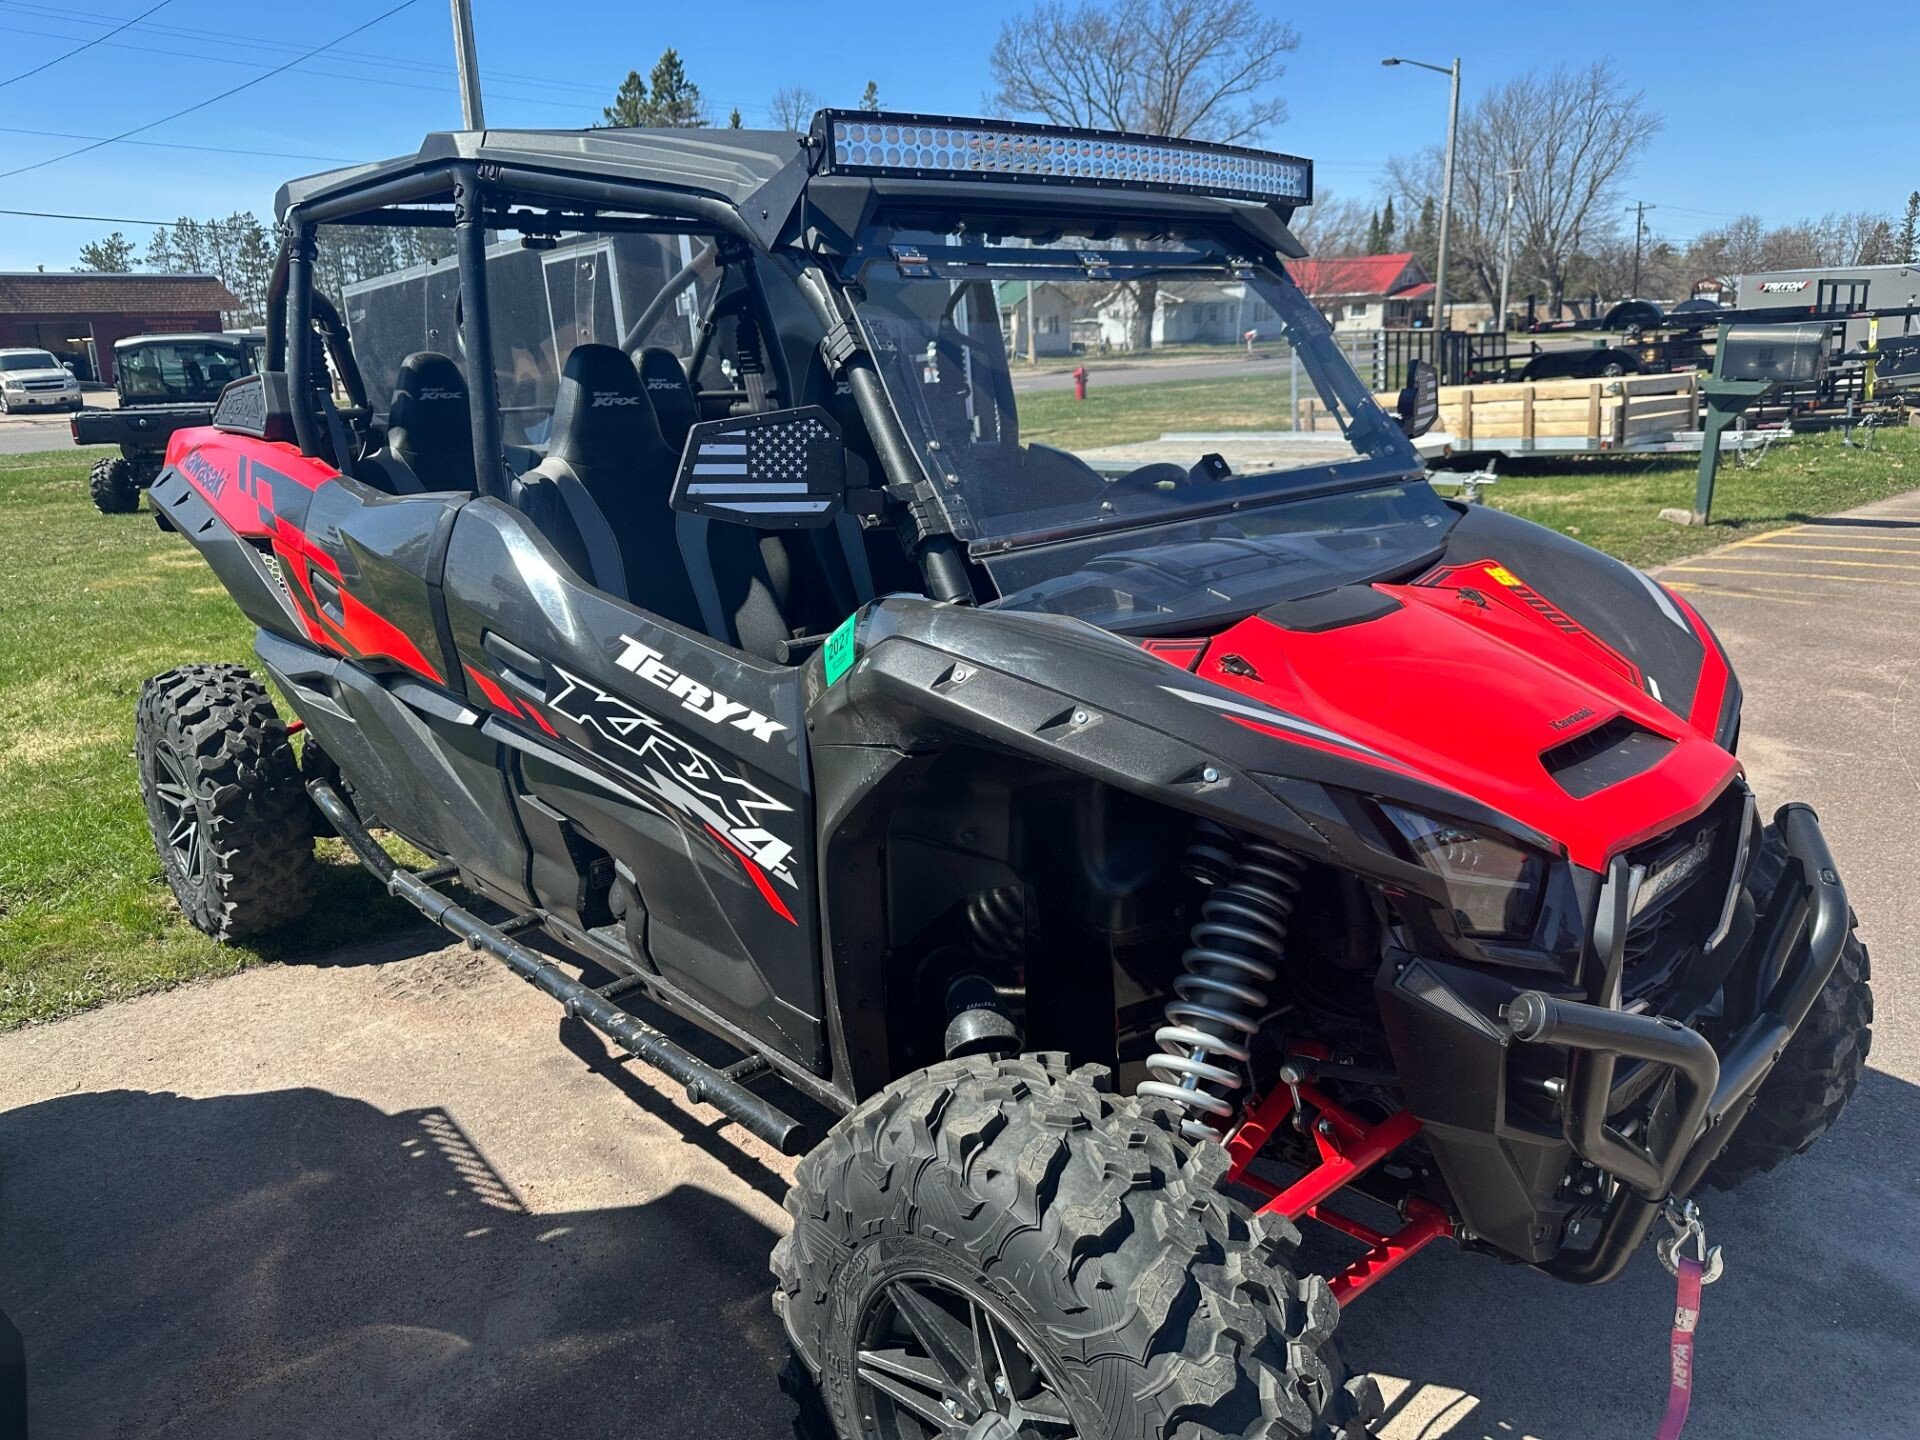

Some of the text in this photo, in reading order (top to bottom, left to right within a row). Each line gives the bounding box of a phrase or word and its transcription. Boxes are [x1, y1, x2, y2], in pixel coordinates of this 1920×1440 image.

[418, 391, 463, 401] KRX
[591, 396, 640, 408] KRX
[181, 450, 231, 501] Kawasaki
[828, 627, 851, 661] 2027
[1549, 706, 1594, 731] Kawasaki
[1671, 1343, 1690, 1390] WARN
